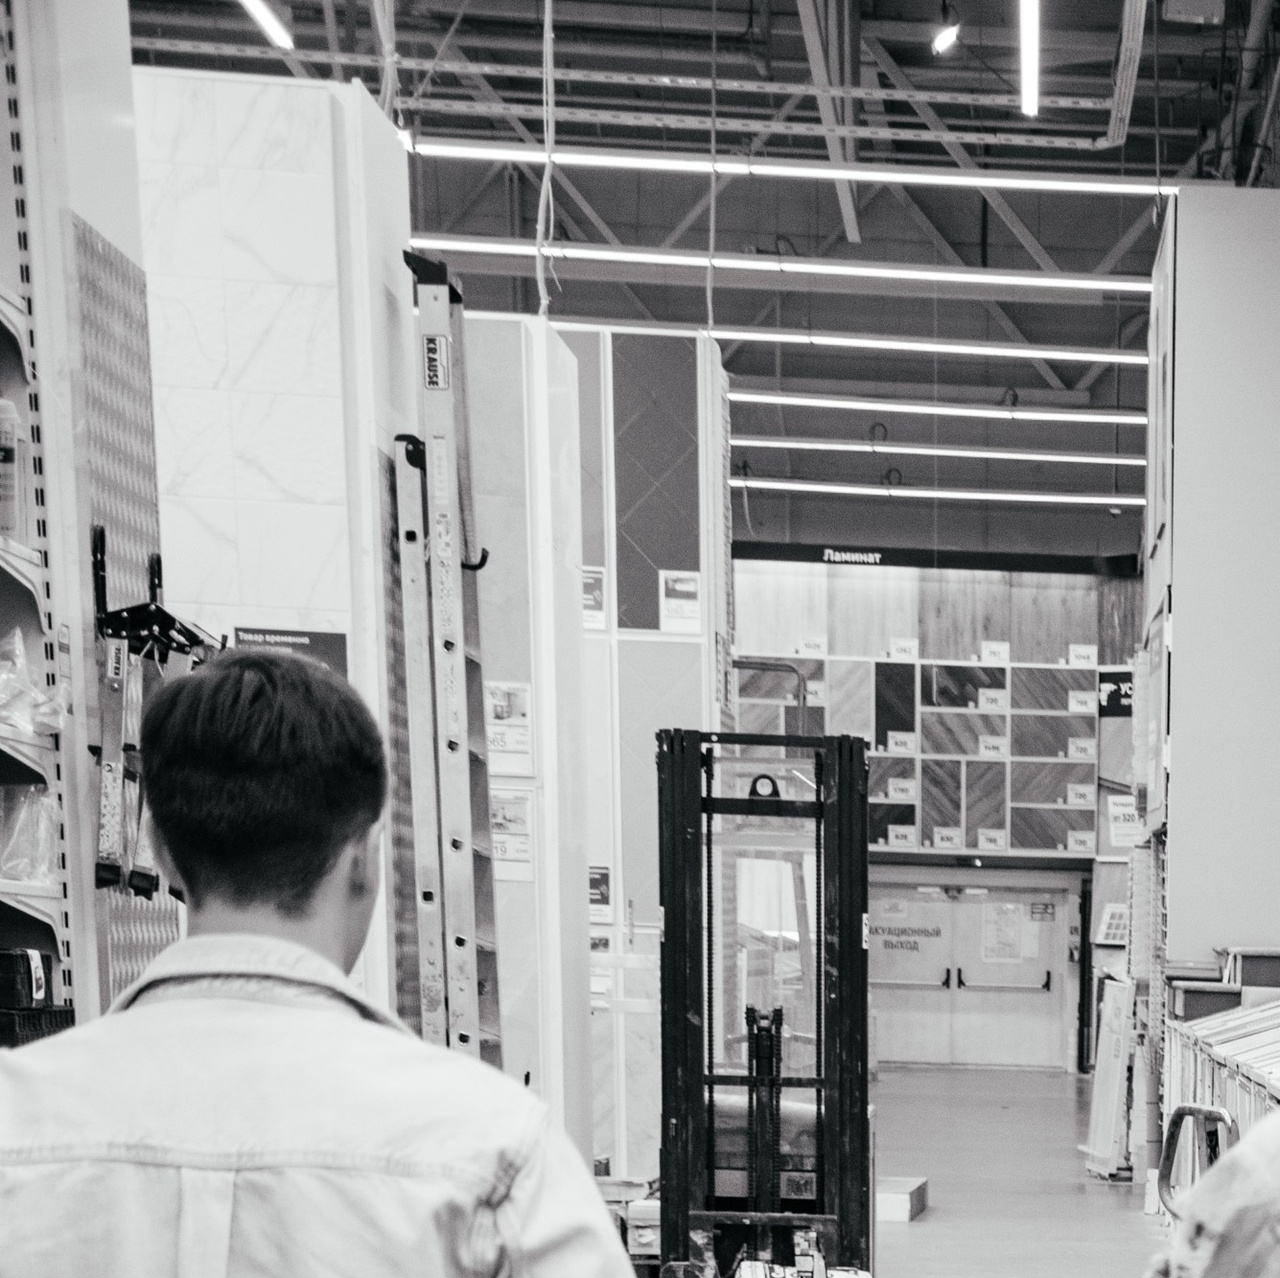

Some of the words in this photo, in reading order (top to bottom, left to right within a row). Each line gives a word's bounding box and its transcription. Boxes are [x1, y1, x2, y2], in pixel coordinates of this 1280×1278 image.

[426, 337, 439, 387] KRAUSE
[823, 548, 882, 564] Ламинат
[238, 631, 264, 643] Товар
[1122, 813, 1136, 822] 320
[884, 940, 919, 951] ВЫХОД
